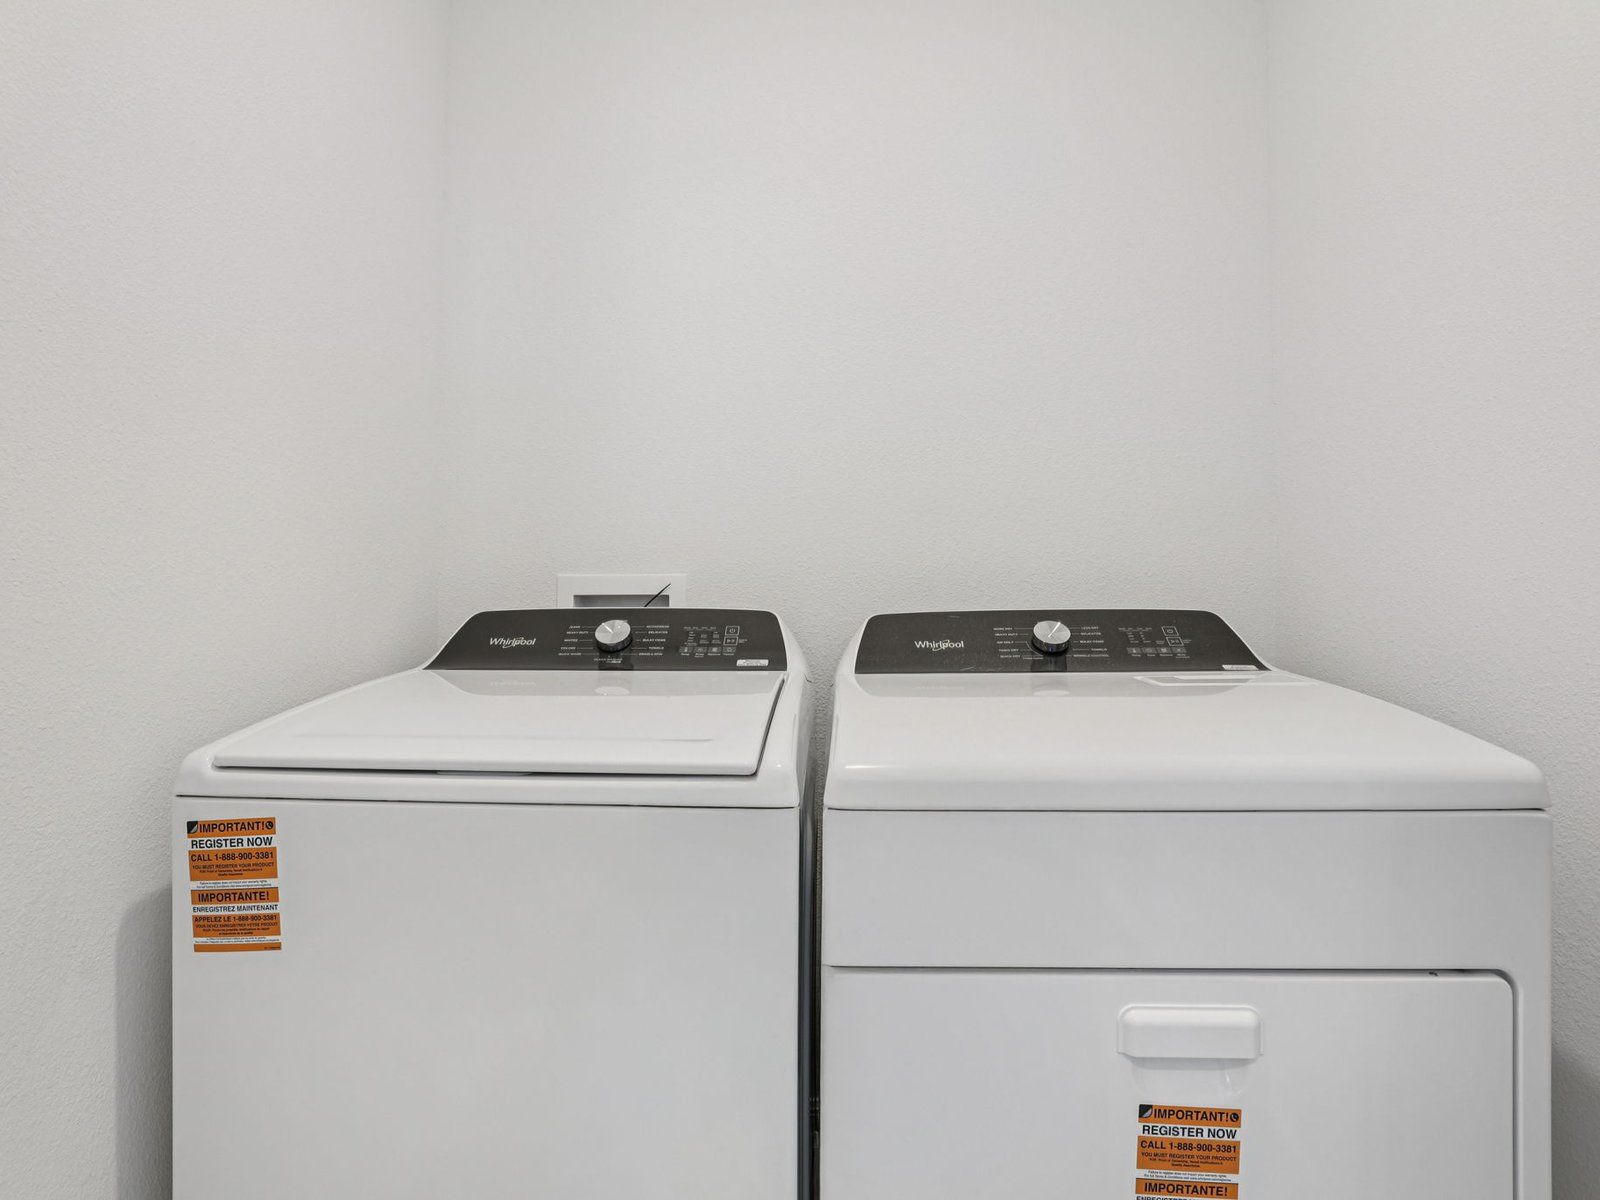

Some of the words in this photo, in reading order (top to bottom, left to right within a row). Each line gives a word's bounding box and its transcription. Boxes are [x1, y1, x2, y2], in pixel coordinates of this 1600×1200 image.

[490, 637, 536, 648] Whirlpool
[914, 640, 964, 651] Whirlpool
[200, 821, 264, 833] IMPORTANT!
[191, 838, 244, 849] REGISTER
[247, 836, 273, 847] NOW
[191, 853, 212, 862] CALL
[214, 852, 274, 861] 1-888-900-3381
[198, 891, 269, 903] IMPORTANTE!
[1154, 1108, 1229, 1122] IMPORTANT!
[1142, 1125, 1204, 1137] REGISTER
[1207, 1128, 1237, 1139] NOW
[1140, 1140, 1166, 1150] CALL
[1169, 1142, 1237, 1153] 1-888-900-3381
[1144, 1182, 1228, 1197] IMPORTANTE!
